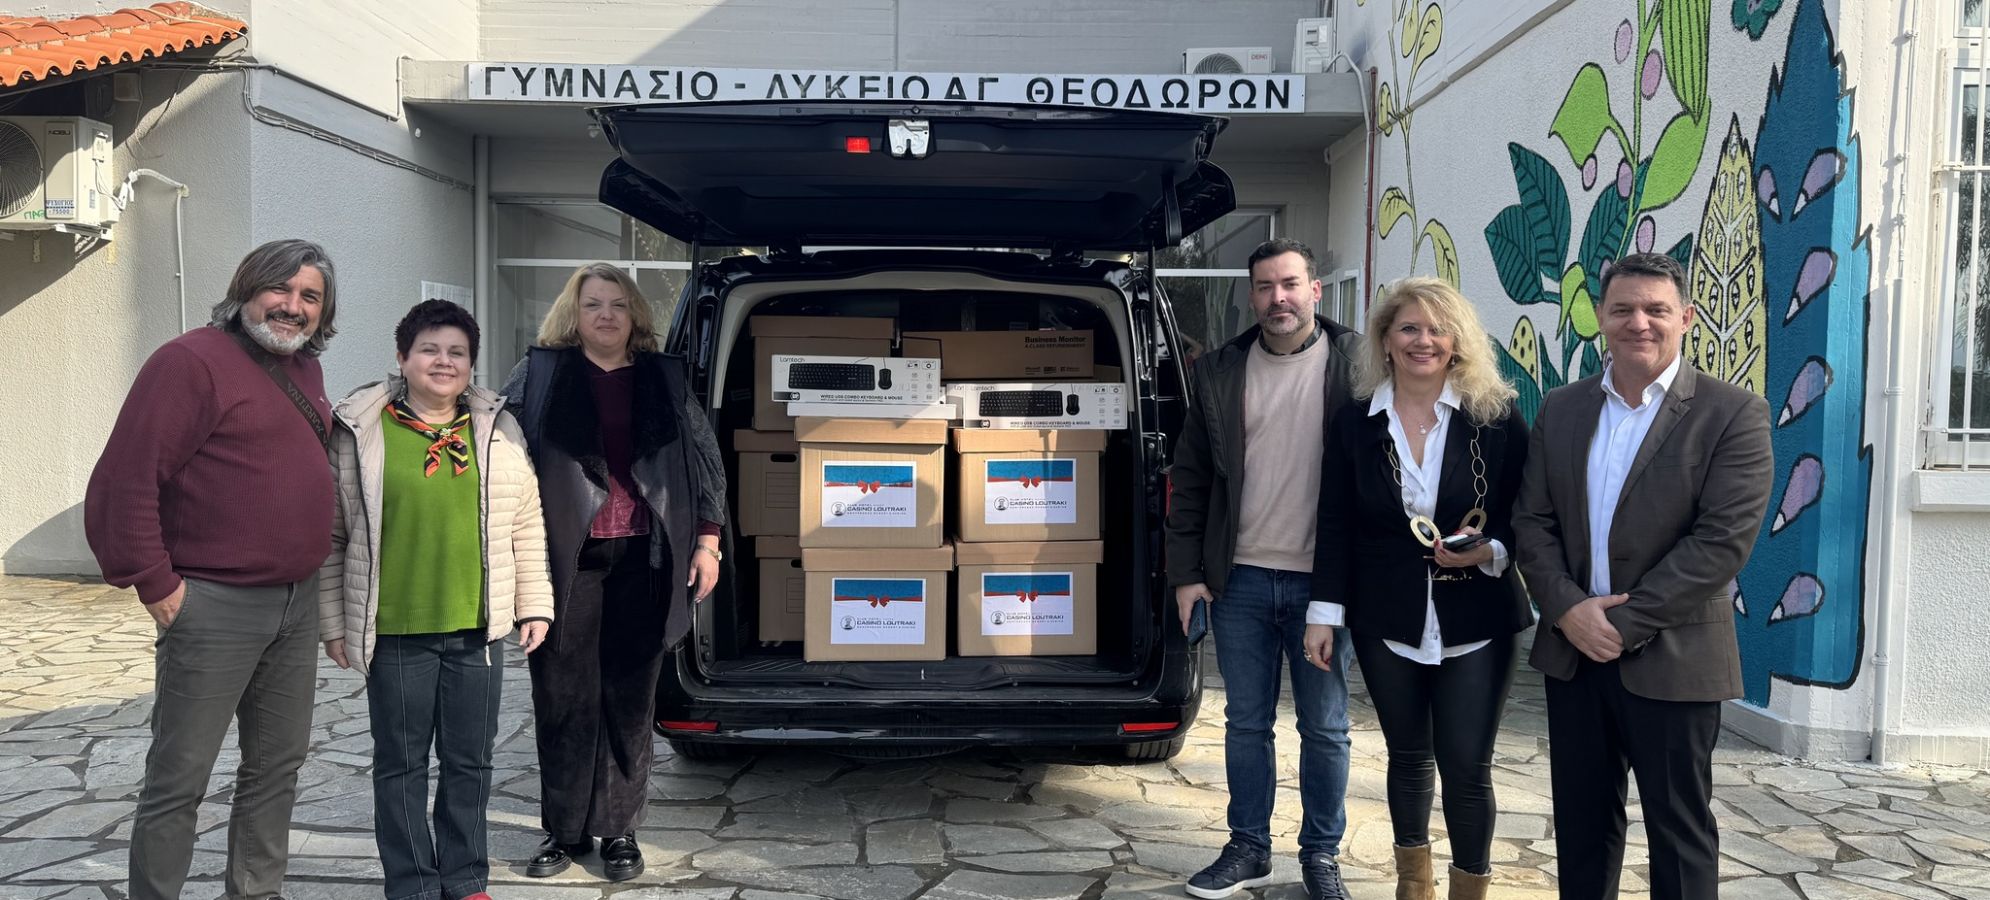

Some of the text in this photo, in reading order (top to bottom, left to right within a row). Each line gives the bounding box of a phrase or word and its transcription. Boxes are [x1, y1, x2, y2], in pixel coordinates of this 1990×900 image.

[484, 66, 719, 100] ΓΥΜΝΑΣΙΟ
[1025, 77, 1290, 110] ΘΕΟΔΩΡΩΝ
[1058, 335, 1086, 343] Monitor
